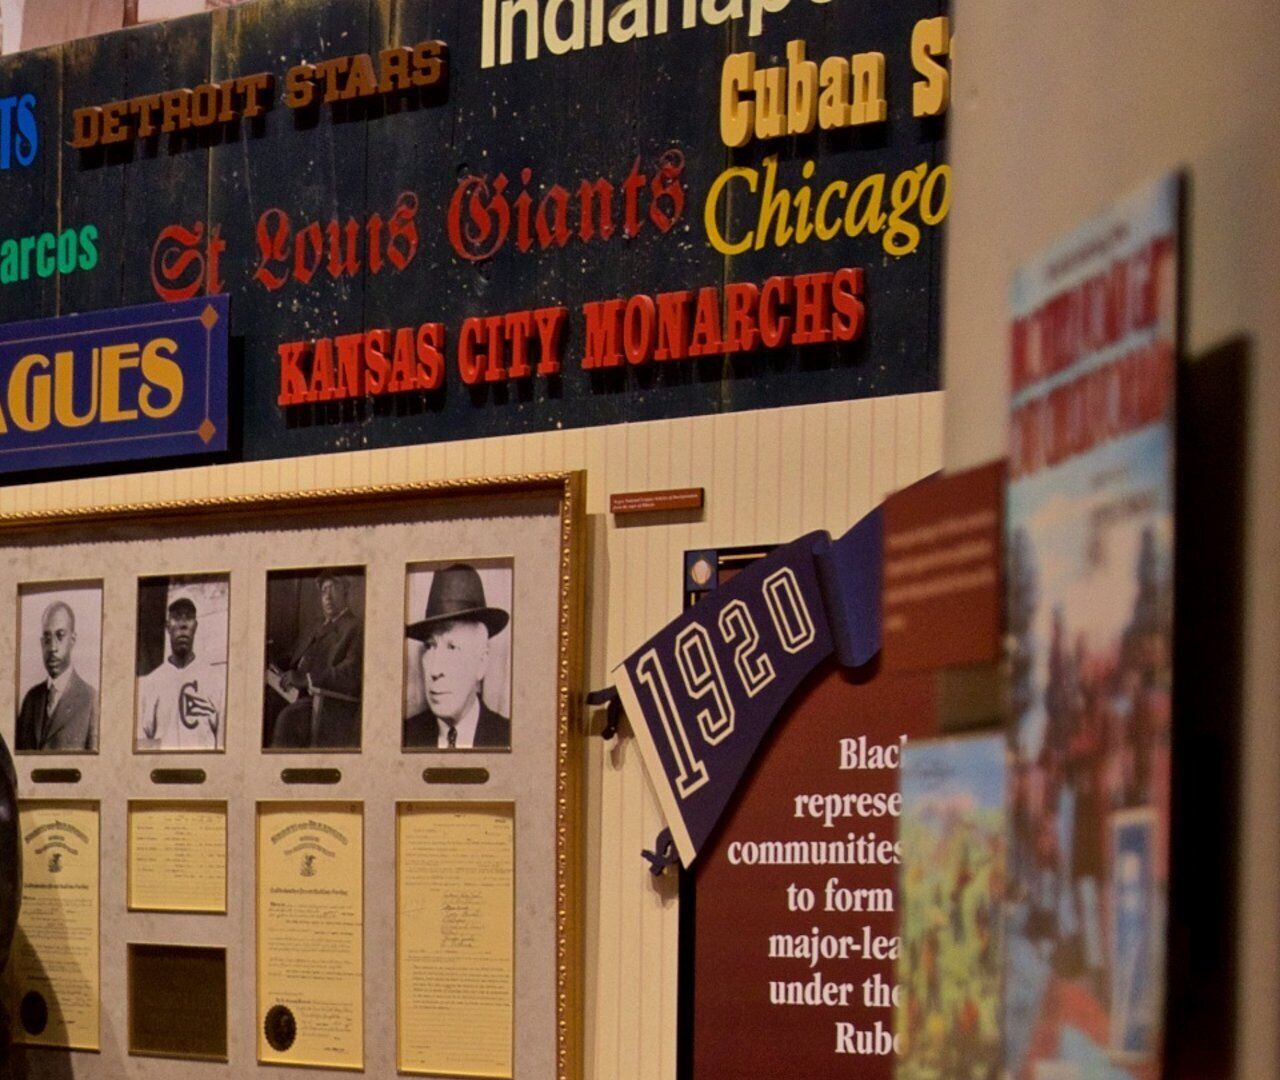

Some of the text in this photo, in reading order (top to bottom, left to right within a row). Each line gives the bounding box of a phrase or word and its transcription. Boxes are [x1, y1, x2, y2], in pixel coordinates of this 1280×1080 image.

[480, 0, 828, 68] Indianap
[72, 41, 448, 149] DETROIT STARS
[720, 17, 954, 147] Cuban S
[151, 149, 686, 301] St Louis Giants
[704, 157, 952, 256] Chicago
[277, 267, 866, 407] KANSAS CITY MONARCHS
[636, 567, 815, 799] 1920
[727, 832, 903, 865] communities
[793, 791, 903, 828] represe
[786, 877, 894, 912] to form
[768, 926, 901, 968] major-lea
[769, 972, 854, 1006] under
